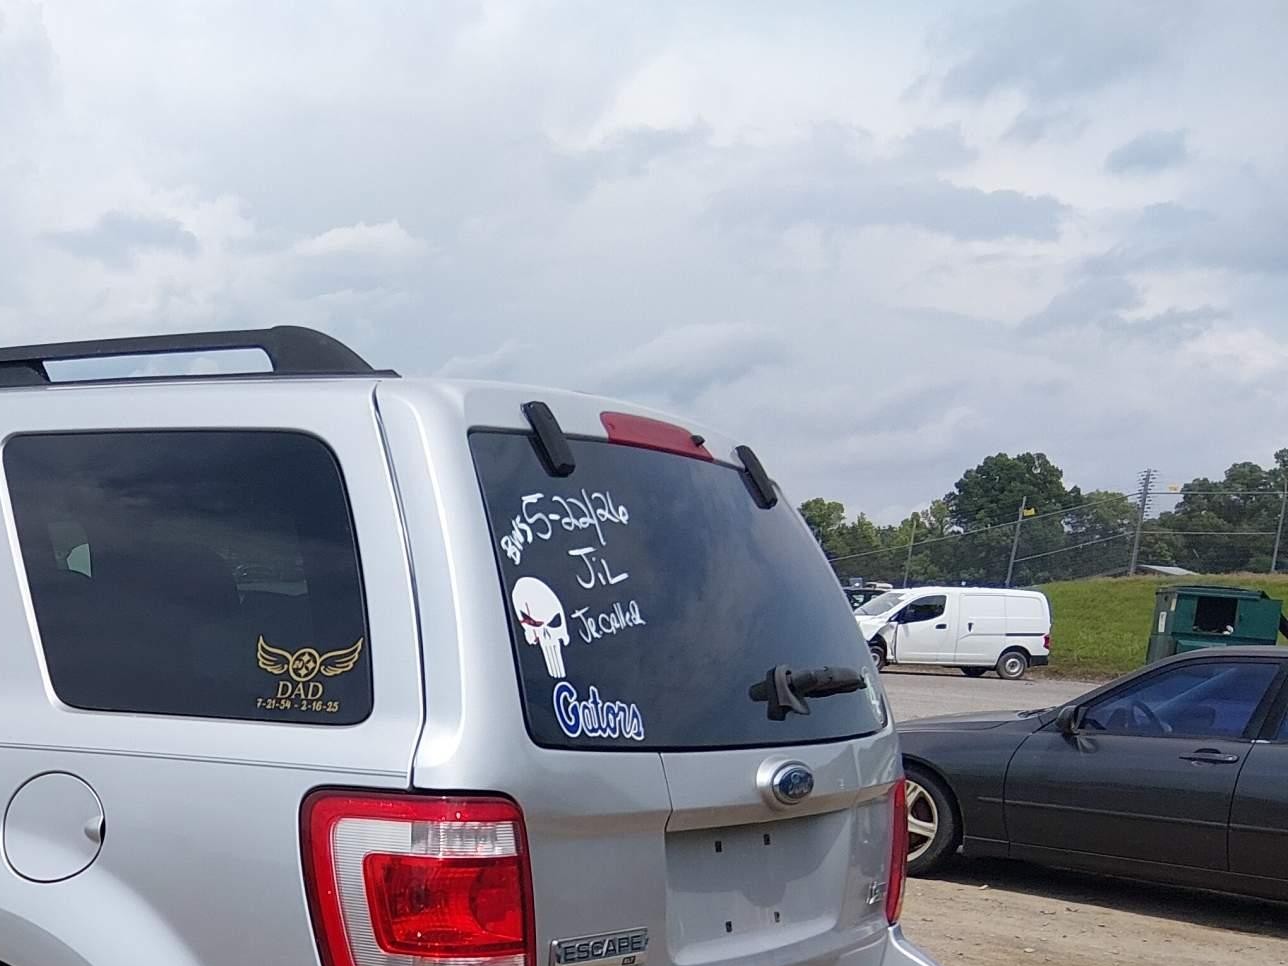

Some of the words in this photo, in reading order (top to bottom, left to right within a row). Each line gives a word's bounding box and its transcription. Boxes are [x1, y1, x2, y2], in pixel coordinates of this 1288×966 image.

[276, 681, 323, 699] DAD
[256, 698, 291, 710] 7-21-54
[301, 700, 339, 712] 2-16-25
[554, 682, 644, 741] Gators
[563, 934, 642, 962] ESCAPE
